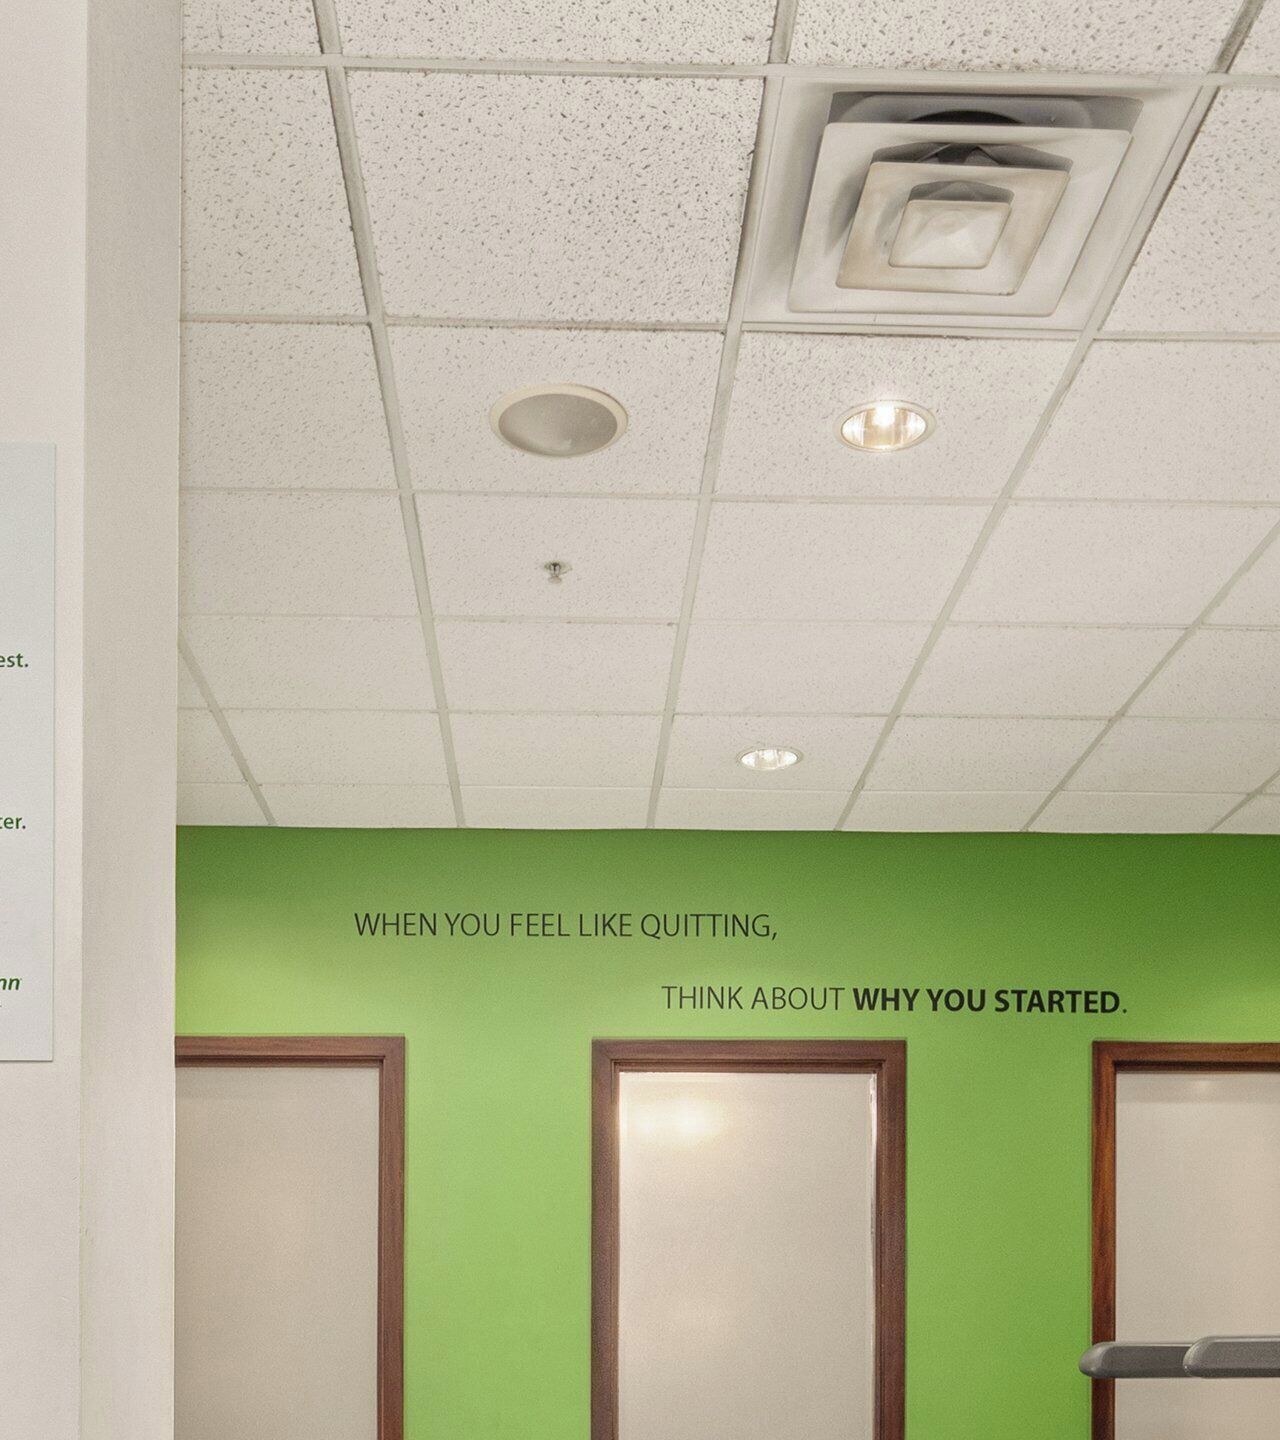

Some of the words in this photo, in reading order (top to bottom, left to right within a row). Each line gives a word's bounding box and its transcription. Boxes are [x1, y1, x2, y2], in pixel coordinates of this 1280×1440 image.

[353, 912, 437, 937] WHEN
[443, 912, 500, 937] YOU
[510, 912, 571, 937] FEEL
[579, 912, 633, 938] LIKE
[640, 913, 778, 941] QUITTING,
[660, 985, 744, 1010] THINK
[750, 986, 846, 1011] ABOUT
[852, 987, 921, 1012] WHY
[925, 988, 987, 1013] YOU
[994, 988, 1128, 1014] STARTED.
